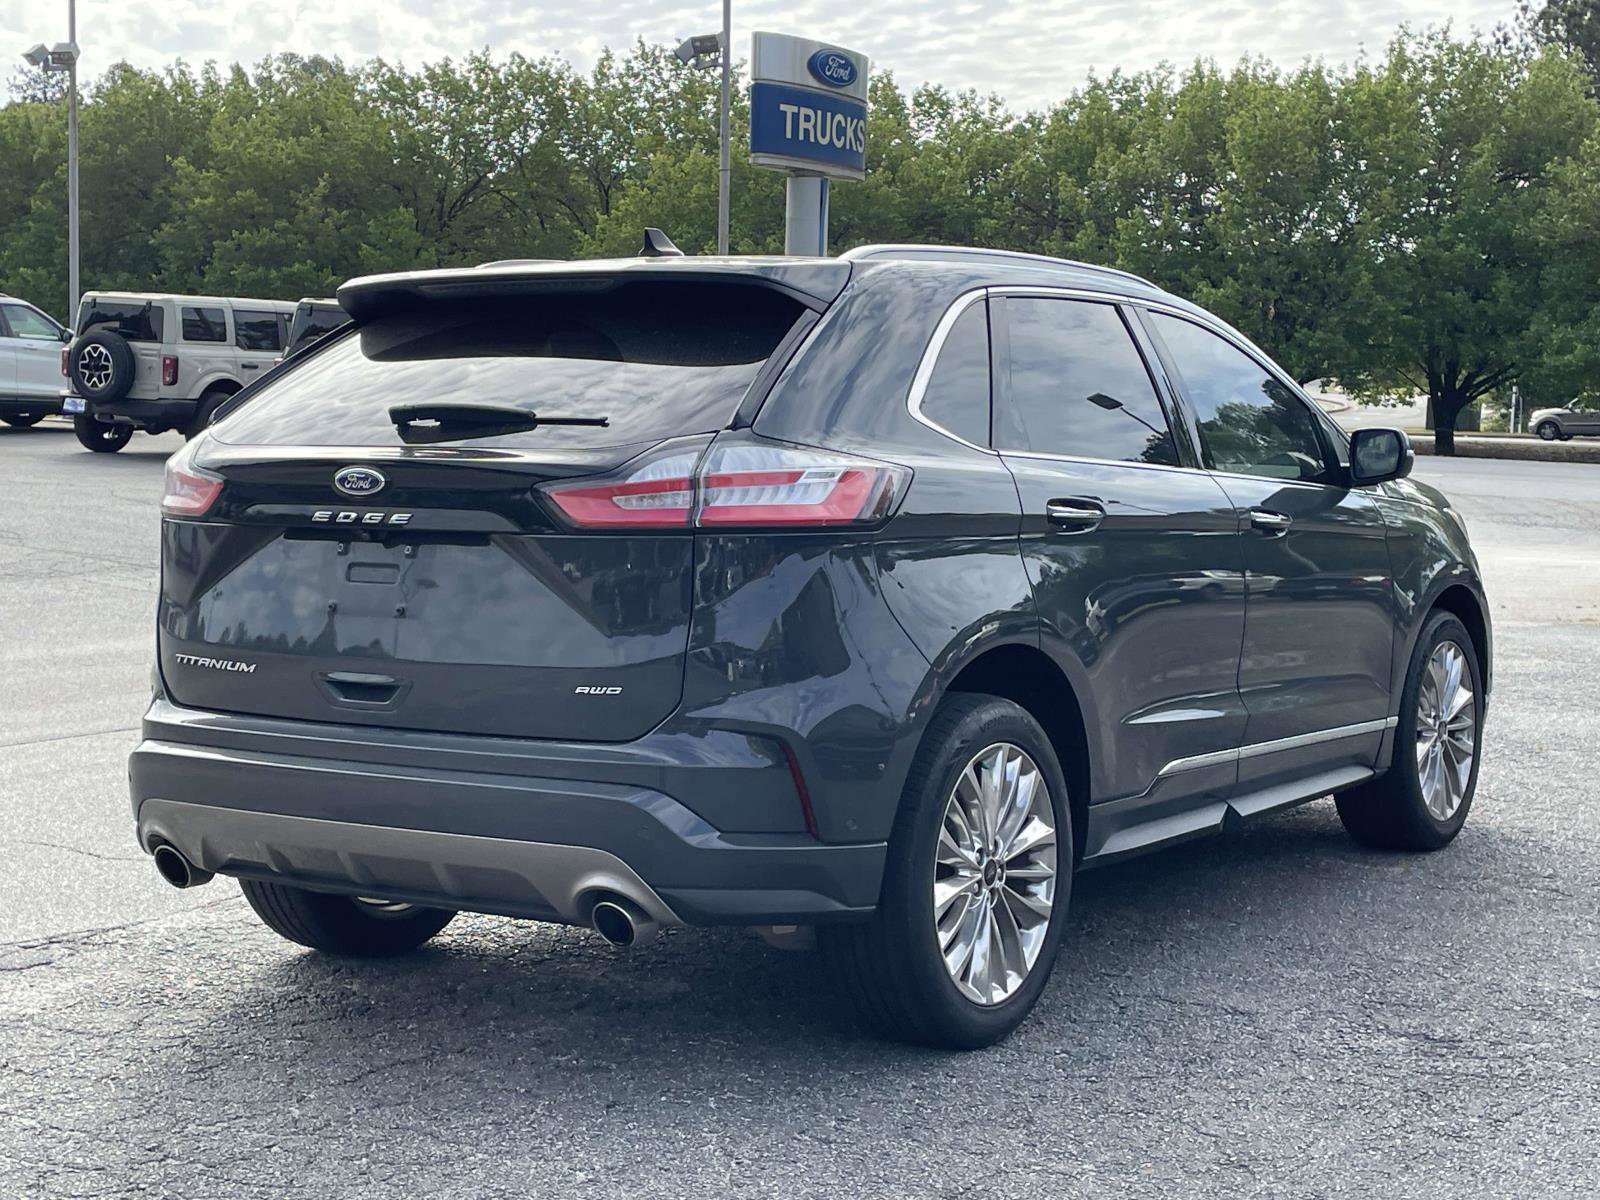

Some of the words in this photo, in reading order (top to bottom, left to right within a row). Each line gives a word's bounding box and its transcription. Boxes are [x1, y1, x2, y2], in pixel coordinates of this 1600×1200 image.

[824, 55, 852, 81] Ford
[779, 103, 866, 154] TRUCKS
[344, 473, 372, 489] Ford
[311, 511, 413, 525] EDGE
[175, 653, 257, 673] TITANIUM
[574, 686, 623, 695] AWD
